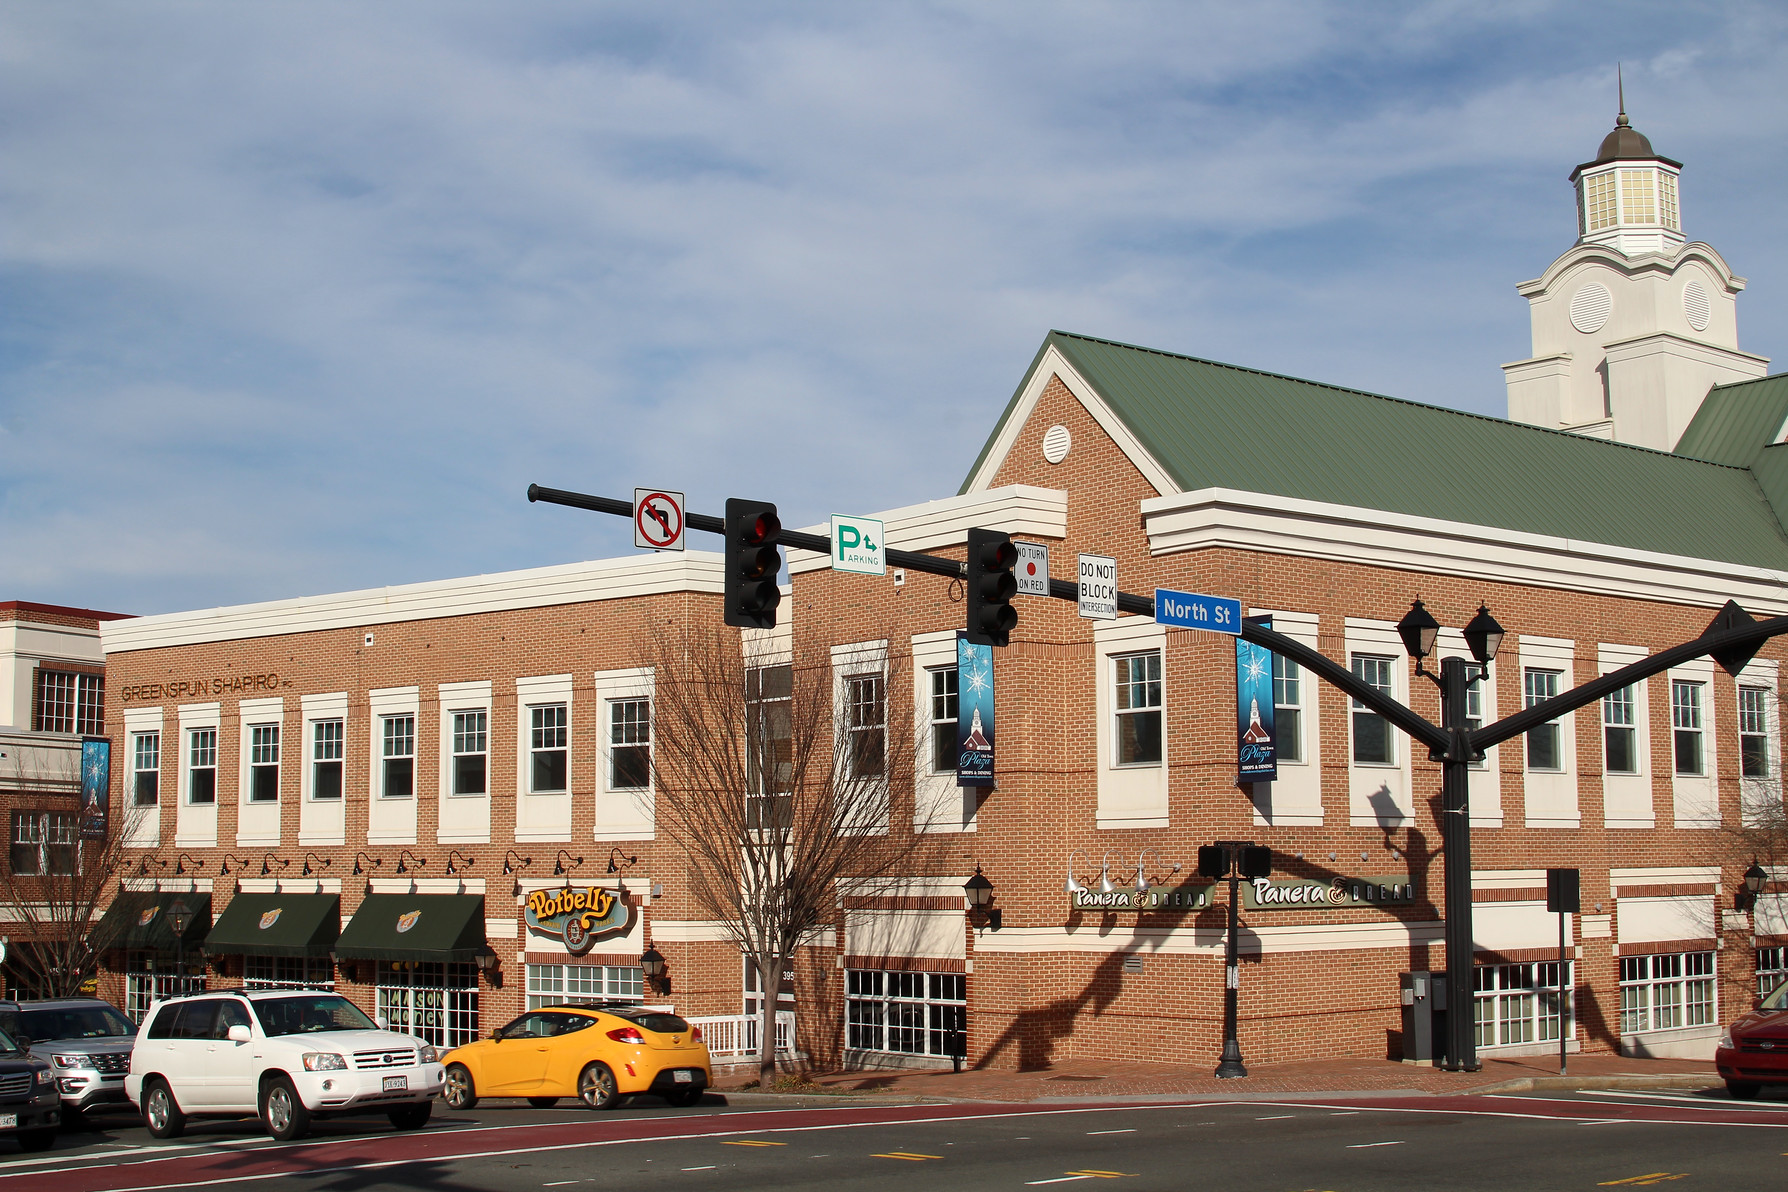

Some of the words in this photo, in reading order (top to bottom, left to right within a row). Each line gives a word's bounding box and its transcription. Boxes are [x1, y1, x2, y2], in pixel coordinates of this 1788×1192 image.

[1028, 548, 1045, 560] TURN
[1081, 562, 1094, 577] DO
[1096, 564, 1115, 579] NOT
[1020, 578, 1029, 589] ON
[1030, 580, 1044, 591] RED
[1081, 582, 1115, 600] BLOCK
[1080, 601, 1115, 614] INTERSECTION
[1164, 598, 1208, 622] North
[1214, 605, 1231, 625] St
[121, 680, 208, 701] GREENSPUN
[212, 673, 279, 694] SHAPIRO
[960, 750, 991, 770] Plaza
[1240, 744, 1271, 763] Plaza
[1074, 887, 1130, 907] Panera
[1151, 893, 1205, 906] BREAD
[1253, 877, 1325, 905] Panera
[1352, 884, 1413, 901] BREAD
[528, 886, 613, 929] Potbelly
[782, 971, 795, 981] 395
